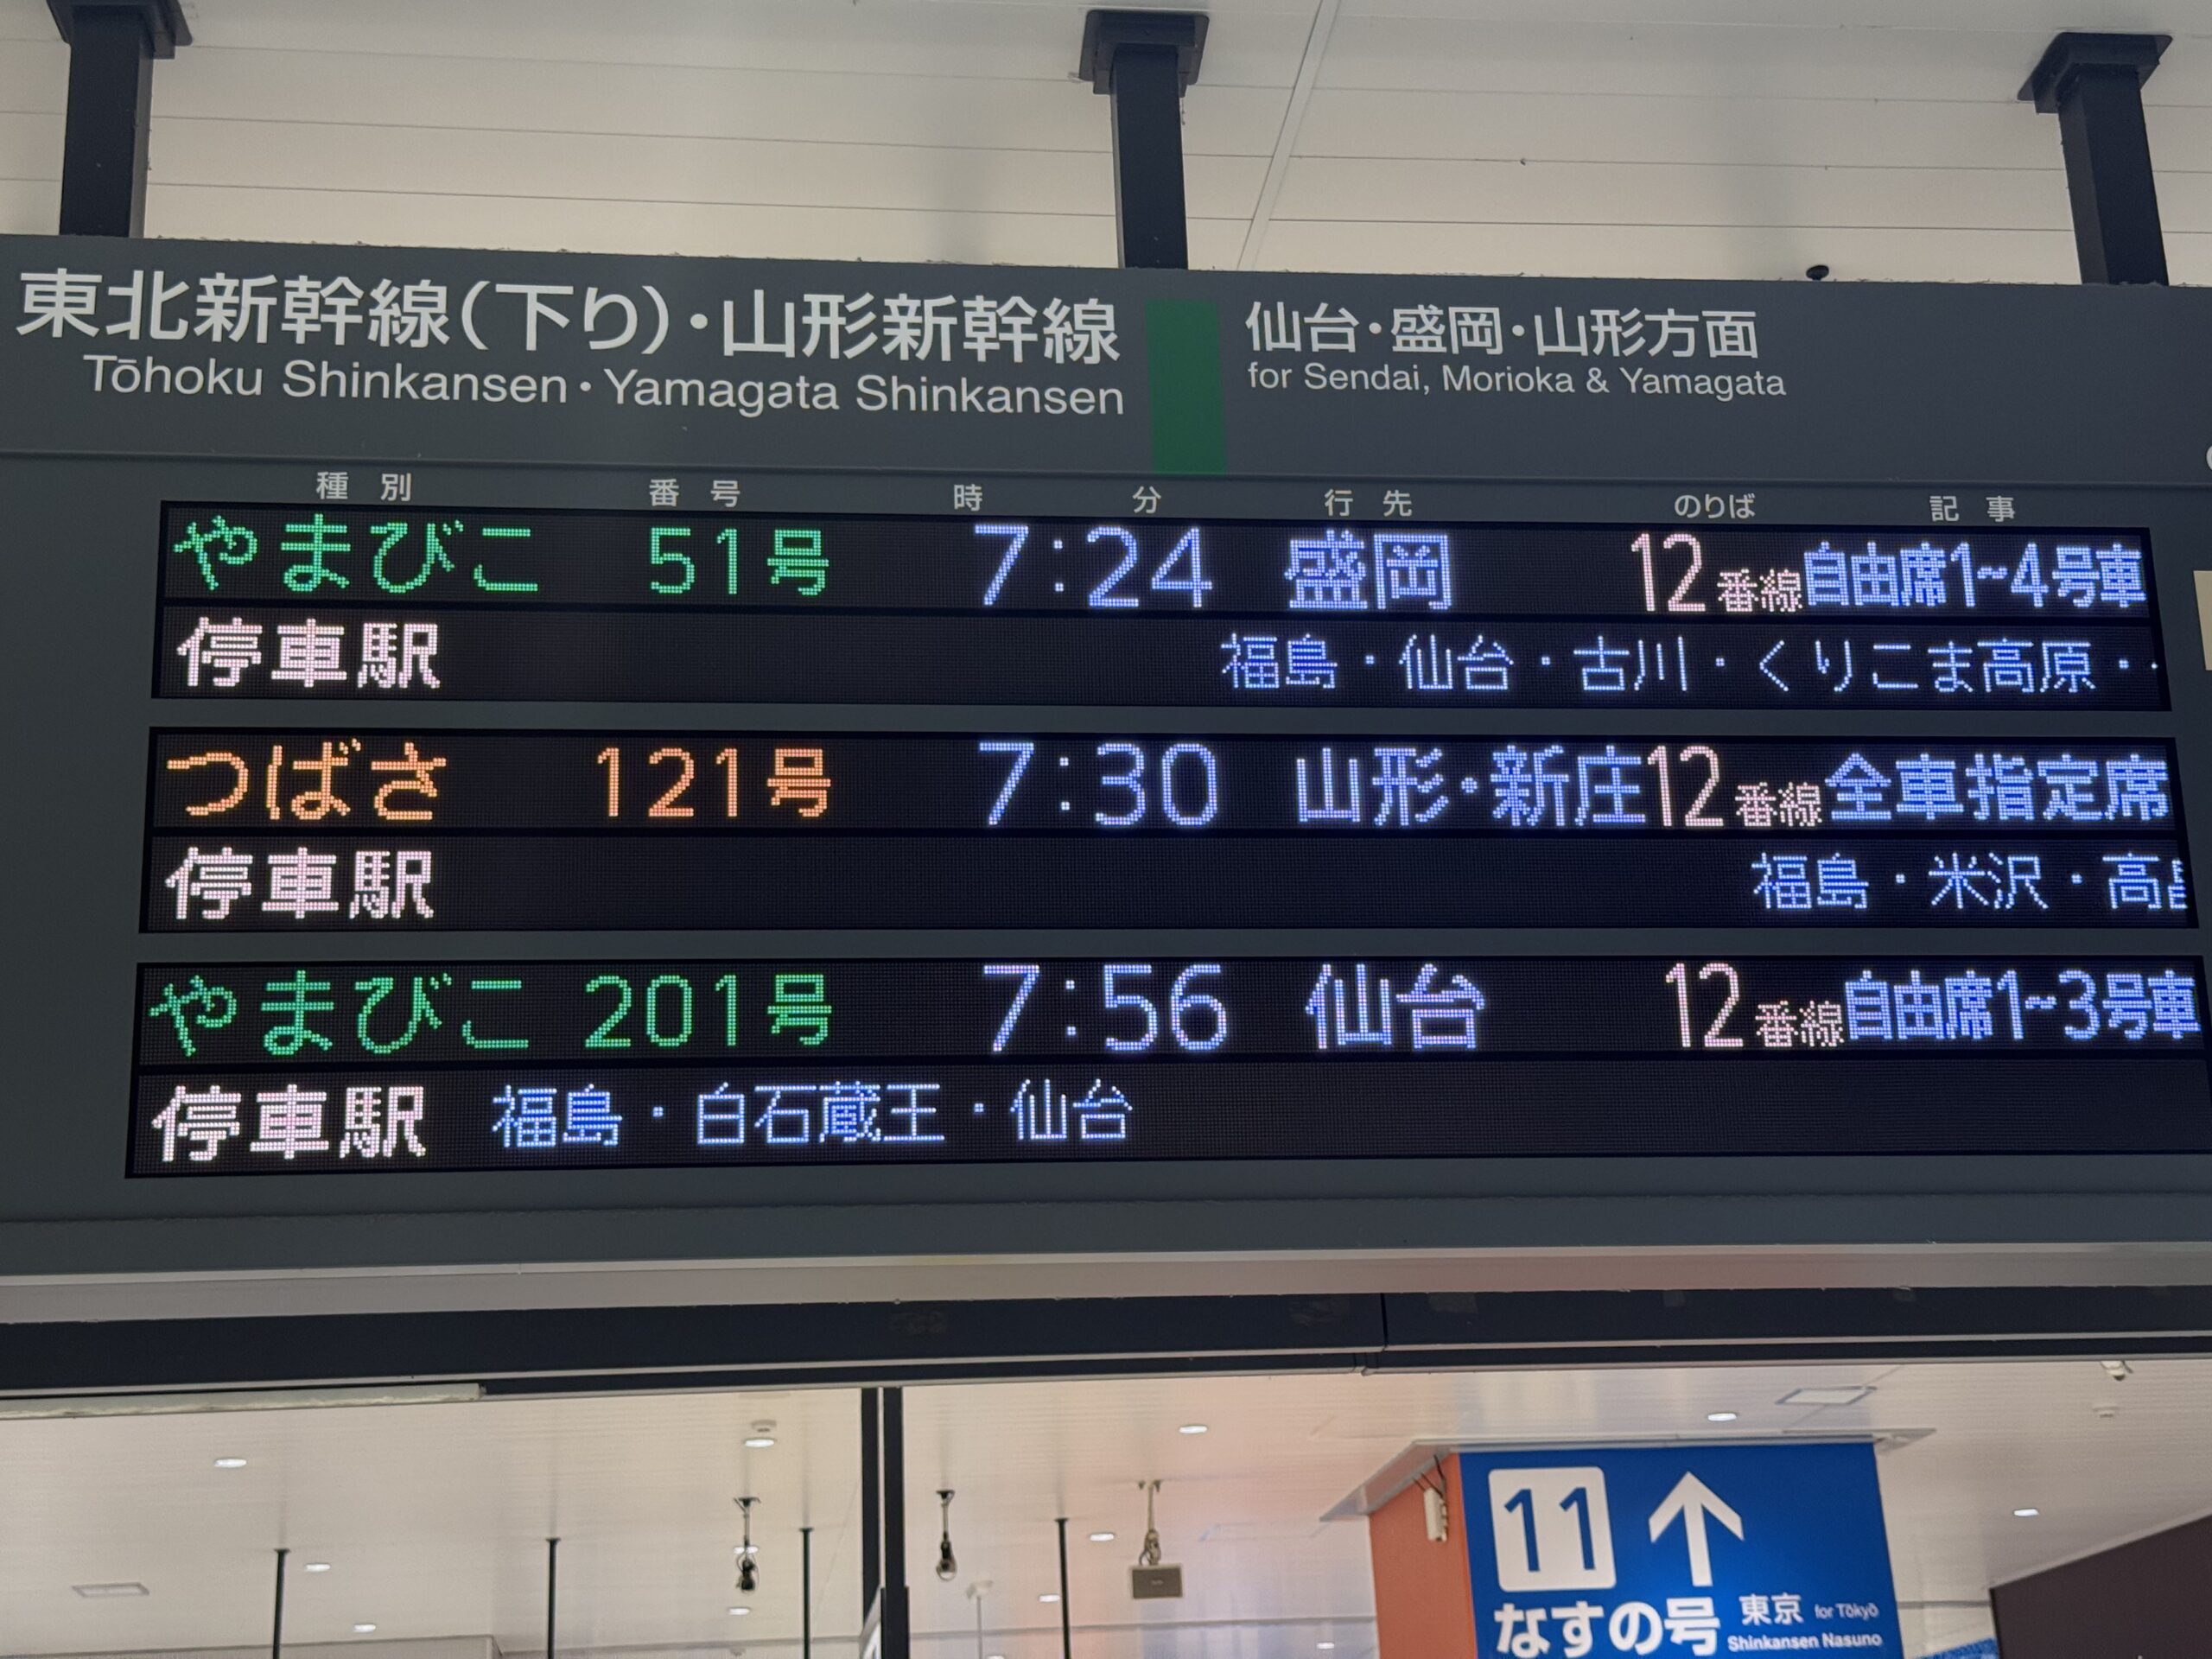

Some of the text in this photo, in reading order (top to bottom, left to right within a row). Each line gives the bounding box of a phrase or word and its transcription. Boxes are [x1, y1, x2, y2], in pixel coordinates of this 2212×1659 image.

[1245, 301, 1759, 359] 仙台・盛岡・山形方面
[83, 354, 263, 396] Tōhoku
[283, 359, 567, 404] Shinkansen
[603, 368, 840, 418] Yamagata
[856, 374, 1123, 415] Shinkansen
[1247, 361, 1787, 402] for Sendai, Morioka & Yamagata
[953, 483, 983, 512] 時
[1132, 486, 1162, 514] 分
[1674, 493, 1756, 519] のりば
[173, 513, 538, 594] やまびこ
[974, 524, 1213, 609] 7:24
[1283, 529, 1452, 611] 盛岡
[176, 616, 441, 690] 停車駅
[167, 738, 447, 821] つばさ
[978, 741, 1218, 828] 7:30
[1296, 744, 1646, 827] 山形・新庄
[164, 846, 435, 920] 停車駅
[149, 969, 530, 1057] やまびこ
[983, 963, 1228, 1052] 7:56
[1305, 963, 1485, 1050] 仙台
[151, 1084, 427, 1162] 停車駅
[1503, 1487, 1595, 1573] 11
[1494, 1596, 1720, 1659] なすの号
[1738, 1592, 1803, 1626] 東京
[1814, 1604, 1834, 1619] for
[1727, 1632, 1883, 1652] Shinkansen Nasuno
